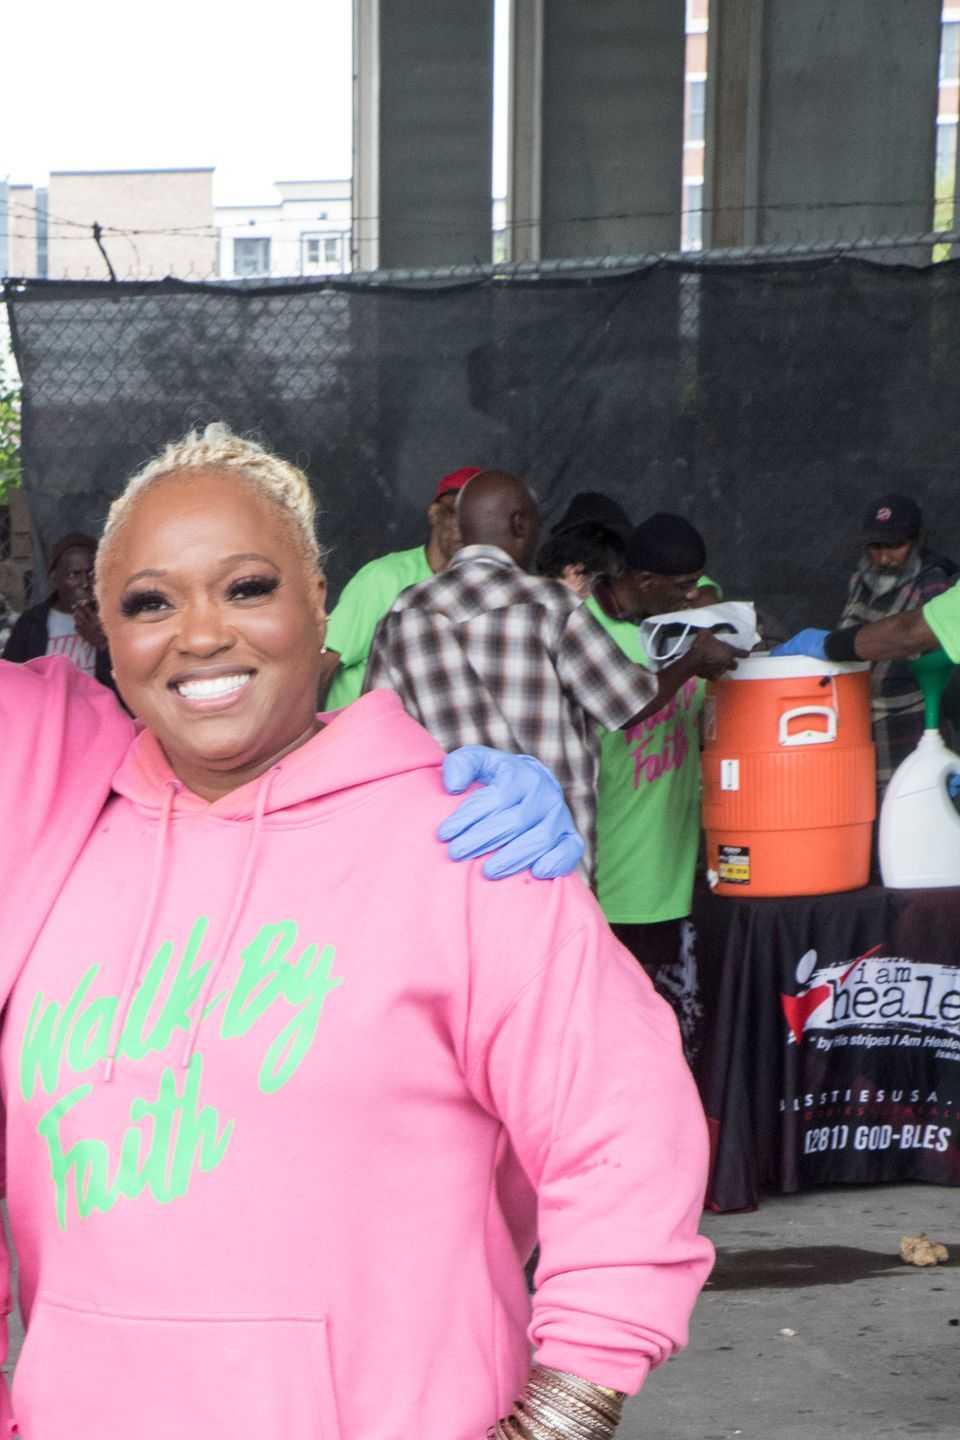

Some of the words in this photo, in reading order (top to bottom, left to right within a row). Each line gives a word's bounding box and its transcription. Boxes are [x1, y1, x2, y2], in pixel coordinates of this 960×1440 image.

[855, 962, 868, 984] i
[875, 966, 912, 984] am
[20, 914, 229, 1101] Walk
[221, 918, 344, 1094] By
[826, 974, 960, 1024] heale
[849, 1034, 891, 1049] stripes
[898, 1034, 921, 1047] Am
[37, 1051, 235, 1232] Faith
[804, 1125, 849, 1154] (281)
[854, 1125, 952, 1152] GOD-BLES
